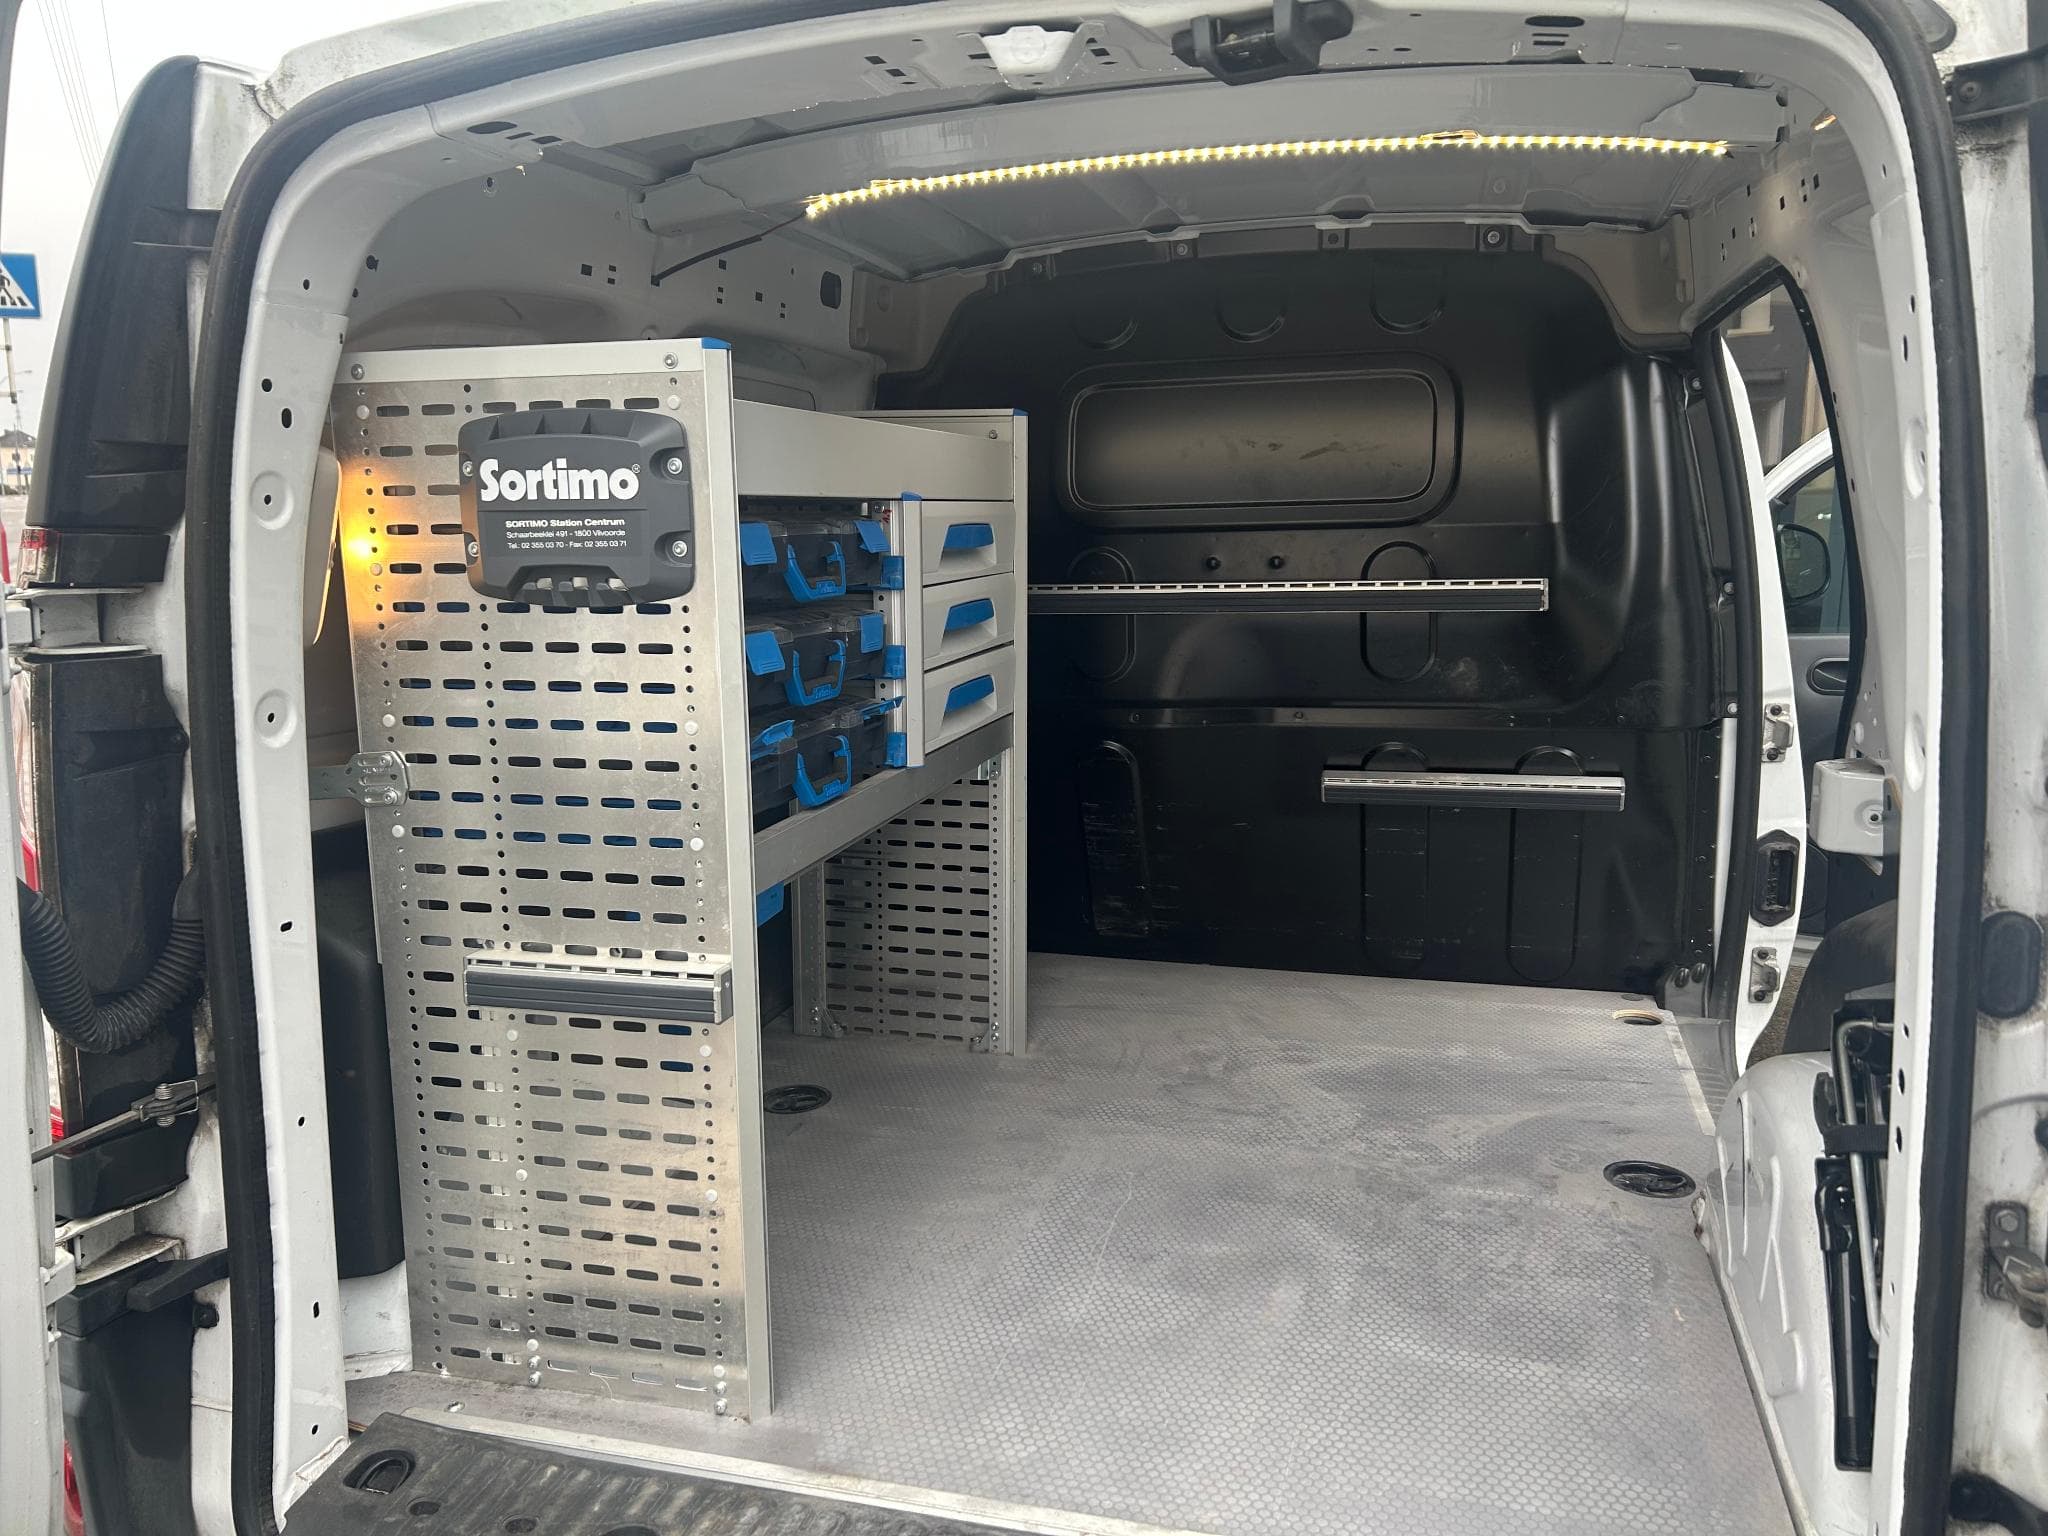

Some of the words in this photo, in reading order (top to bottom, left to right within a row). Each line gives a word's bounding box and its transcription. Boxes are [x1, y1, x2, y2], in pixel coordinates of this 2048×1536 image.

[480, 458, 640, 501] Sortimo
[505, 520, 549, 528] SORTIMO
[550, 519, 583, 527] Station
[584, 518, 625, 526] Centrum
[555, 530, 568, 538] 491
[545, 541, 555, 549] 03
[584, 540, 594, 548] 02
[594, 540, 609, 548] 355
